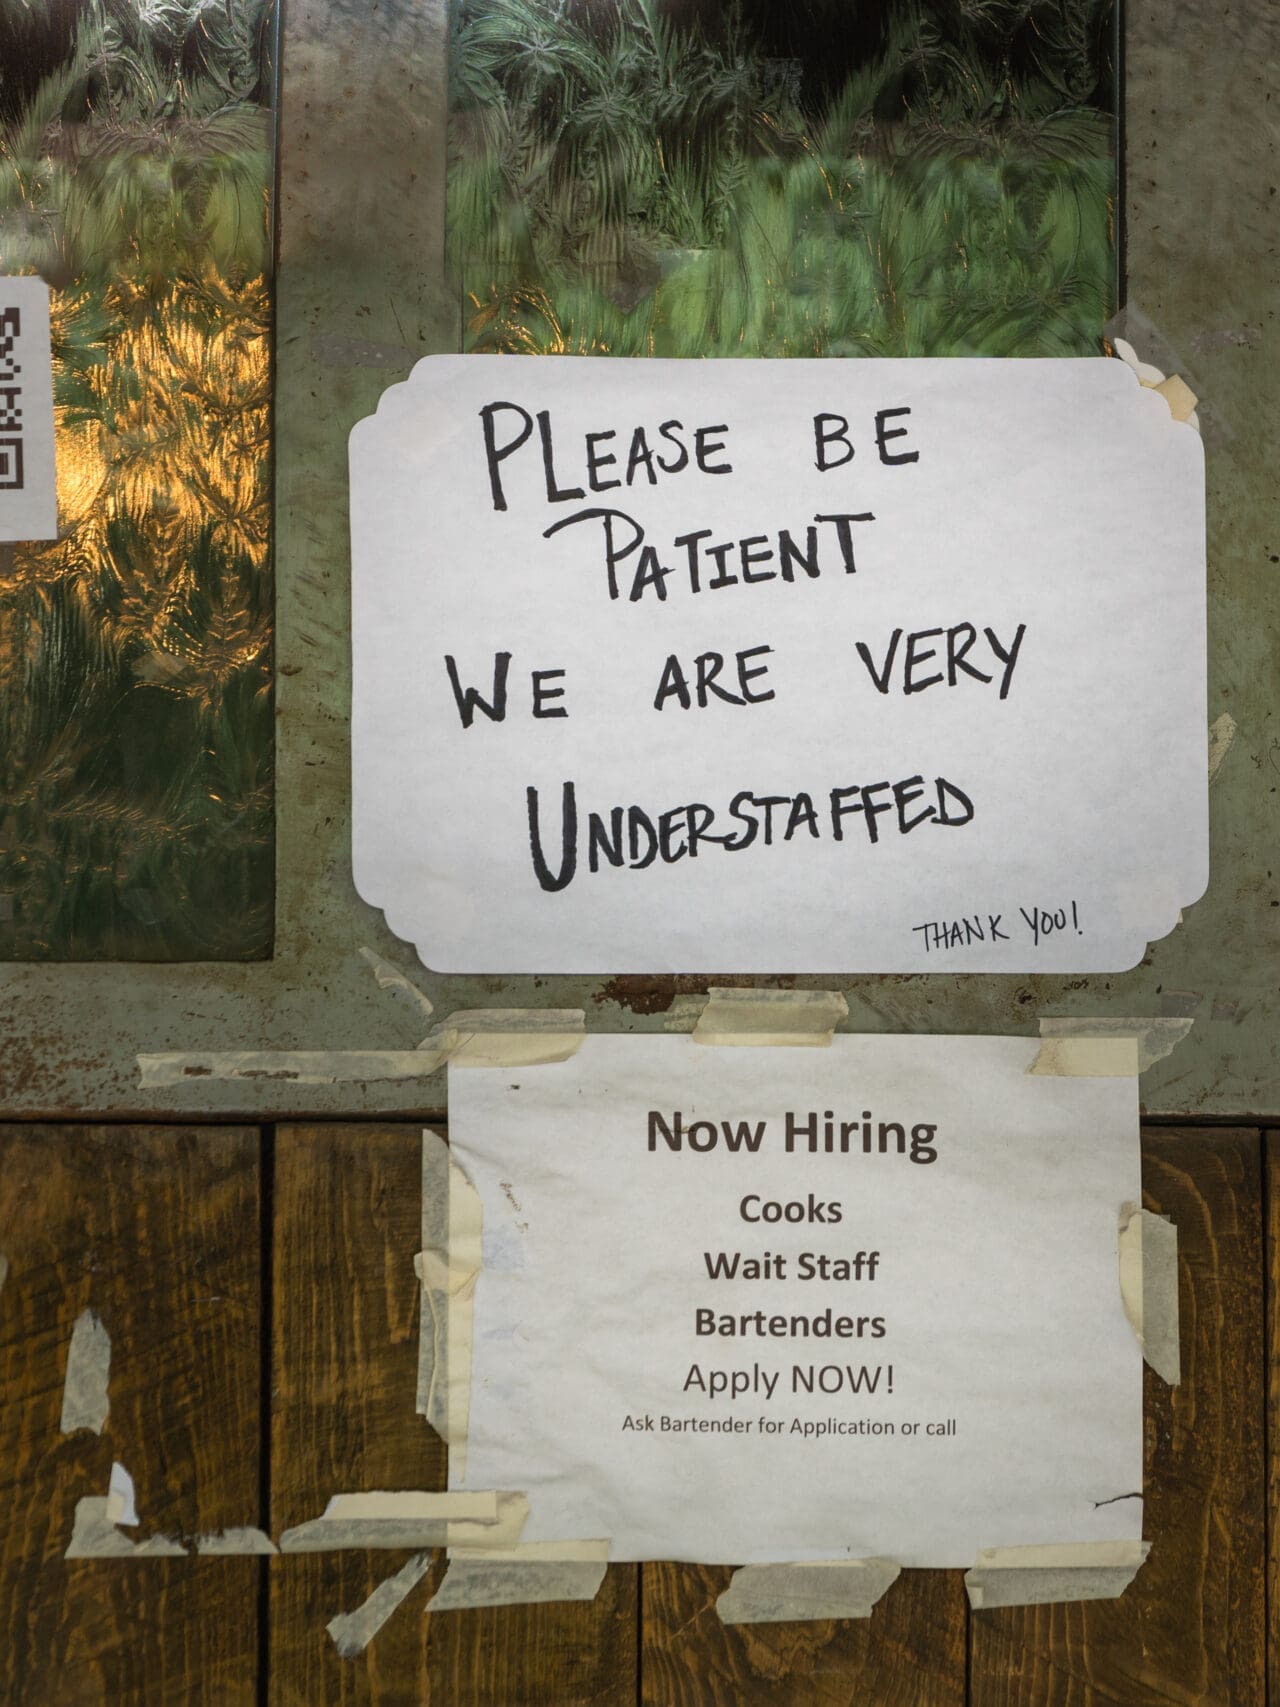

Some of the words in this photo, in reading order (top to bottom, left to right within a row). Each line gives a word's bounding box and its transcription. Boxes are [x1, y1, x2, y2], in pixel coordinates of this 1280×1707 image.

[478, 401, 733, 512] PLEASE
[813, 406, 920, 472] BE
[542, 508, 876, 602] PATIENT
[444, 651, 569, 729] WE
[653, 645, 775, 711] ARE
[855, 621, 1027, 700] VERY
[526, 775, 974, 893] UNDERSTAFFED
[912, 914, 1010, 952] THANK
[1019, 900, 1083, 947] YOU!
[647, 1110, 767, 1153] Now
[785, 1110, 938, 1165] Hiring
[739, 1193, 843, 1224] Cooks
[703, 1251, 787, 1281] Wait
[797, 1251, 880, 1281] Staff
[695, 1308, 886, 1339] Bartenders
[683, 1362, 780, 1400] Apply
[792, 1364, 893, 1394] NOW!
[622, 1414, 654, 1431] Ask
[660, 1415, 753, 1433] Bartender
[758, 1416, 785, 1434] for
[790, 1417, 895, 1438] Application
[901, 1423, 921, 1435] or
[926, 1419, 956, 1436] call
